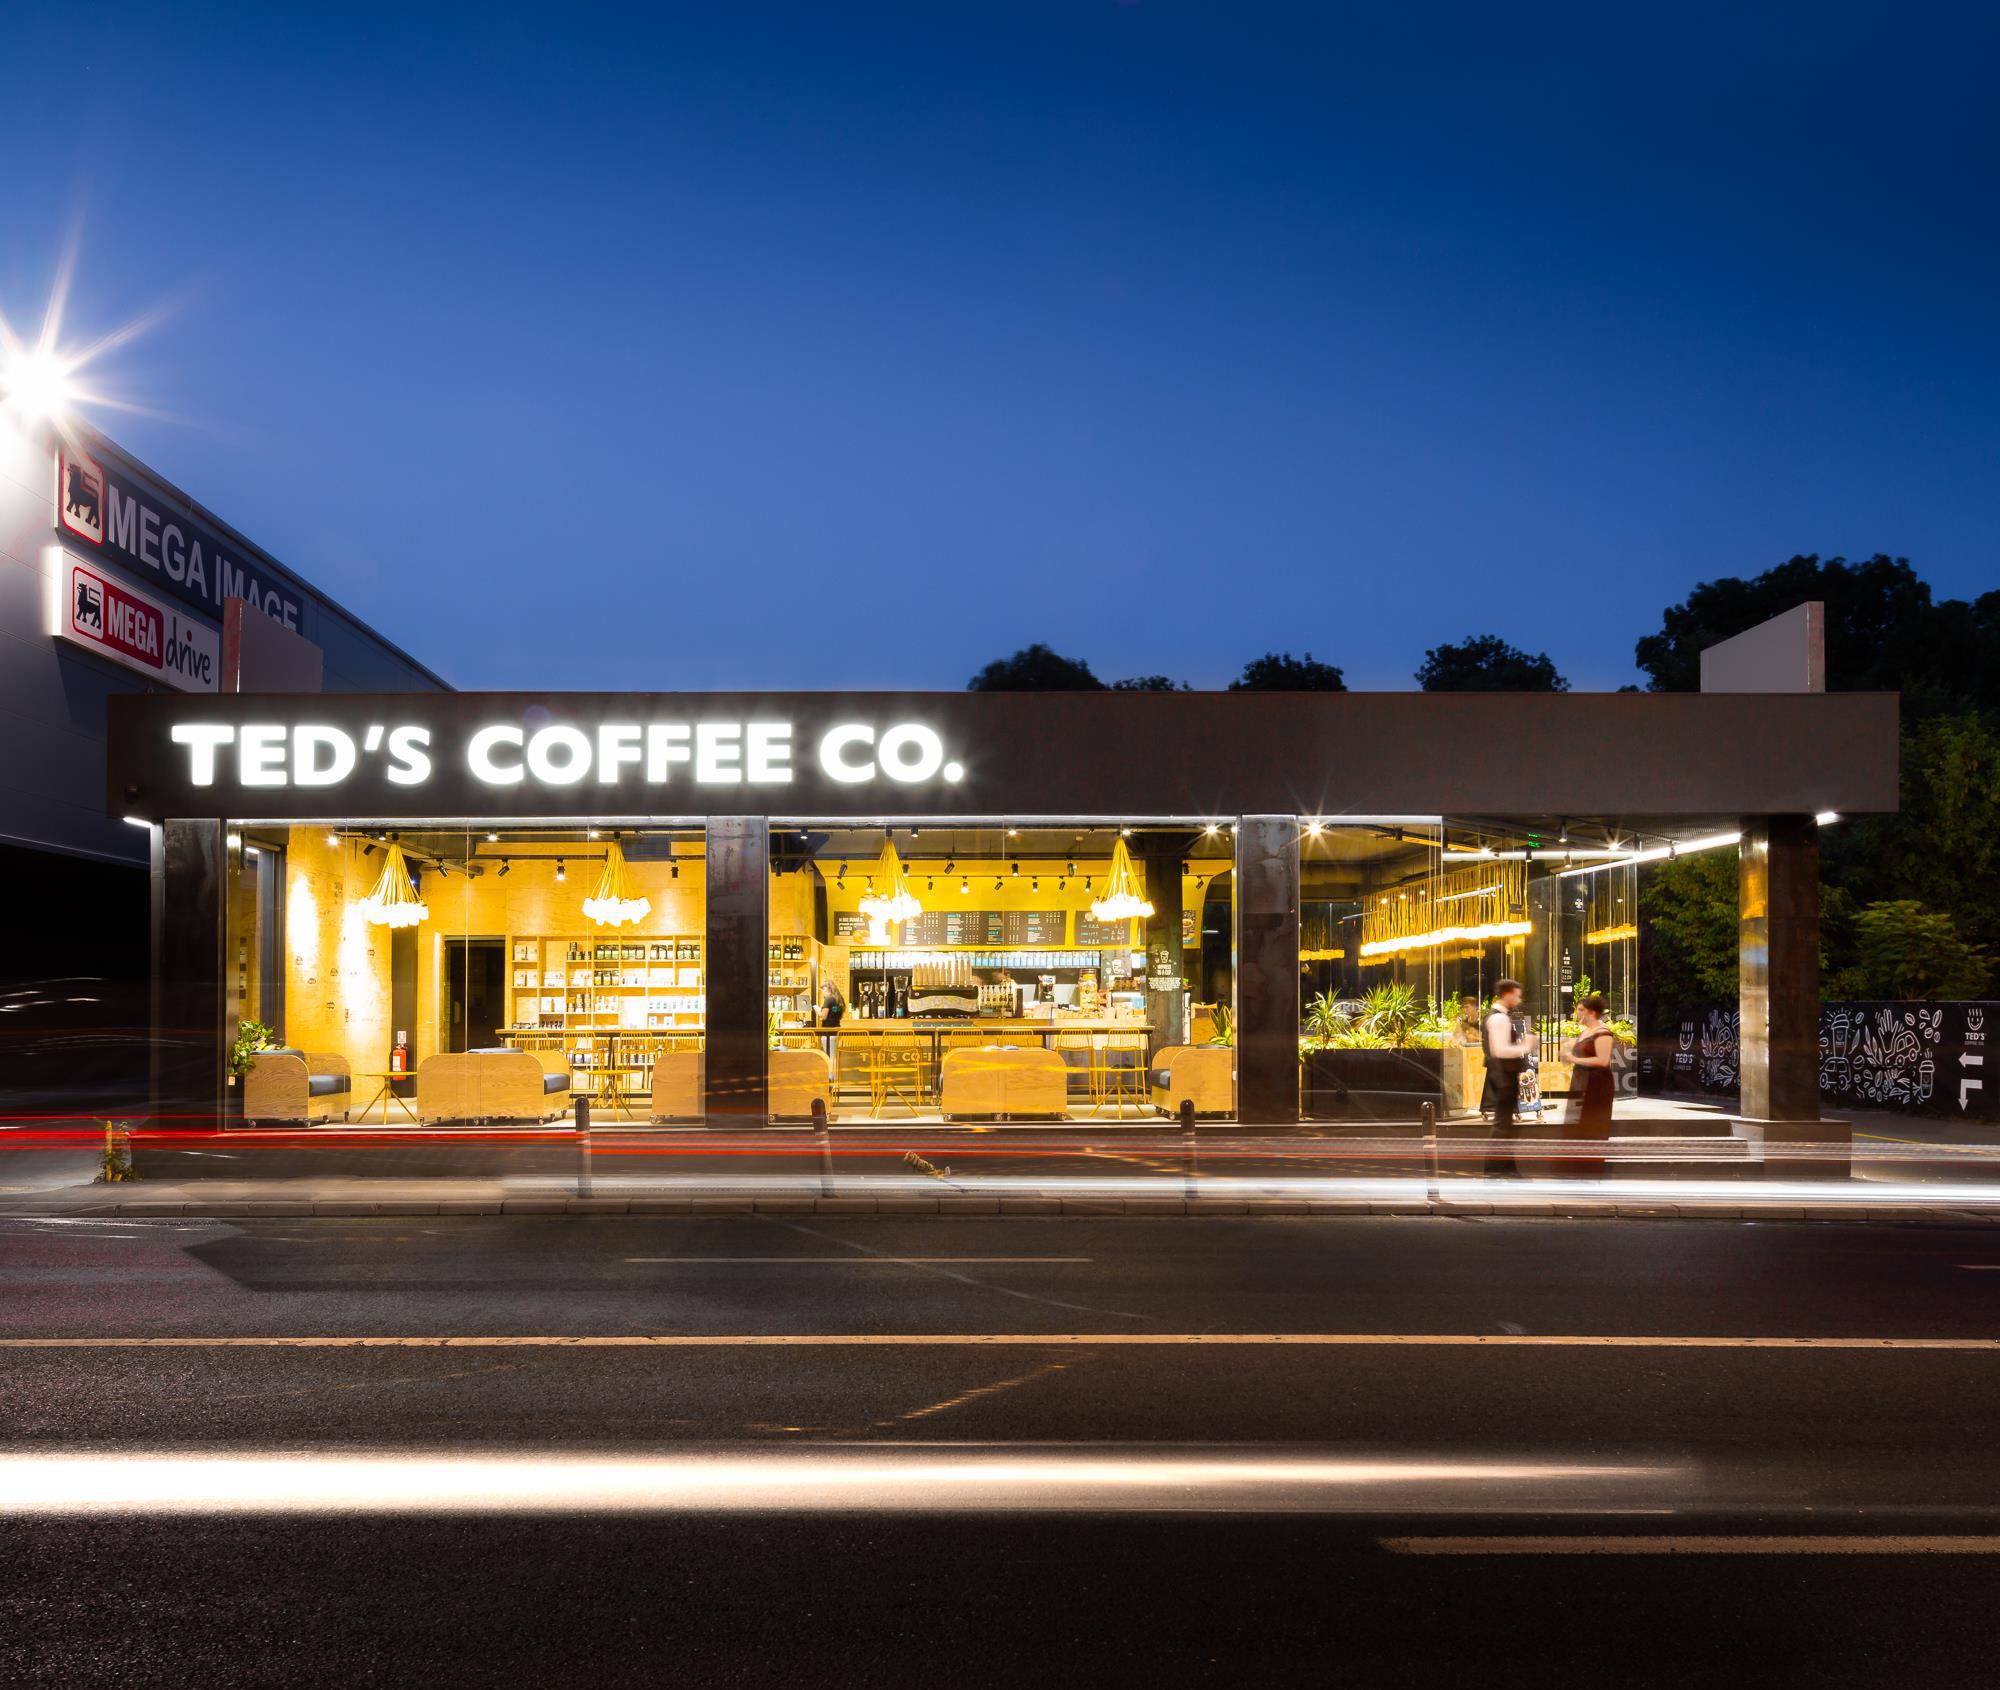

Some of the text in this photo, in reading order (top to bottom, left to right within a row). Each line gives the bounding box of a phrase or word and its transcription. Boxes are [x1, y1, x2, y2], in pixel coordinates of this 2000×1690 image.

[108, 484, 208, 599] MEGA
[108, 596, 211, 684] MEGA drive
[171, 723, 964, 786] TED'S COFFEE CO.
